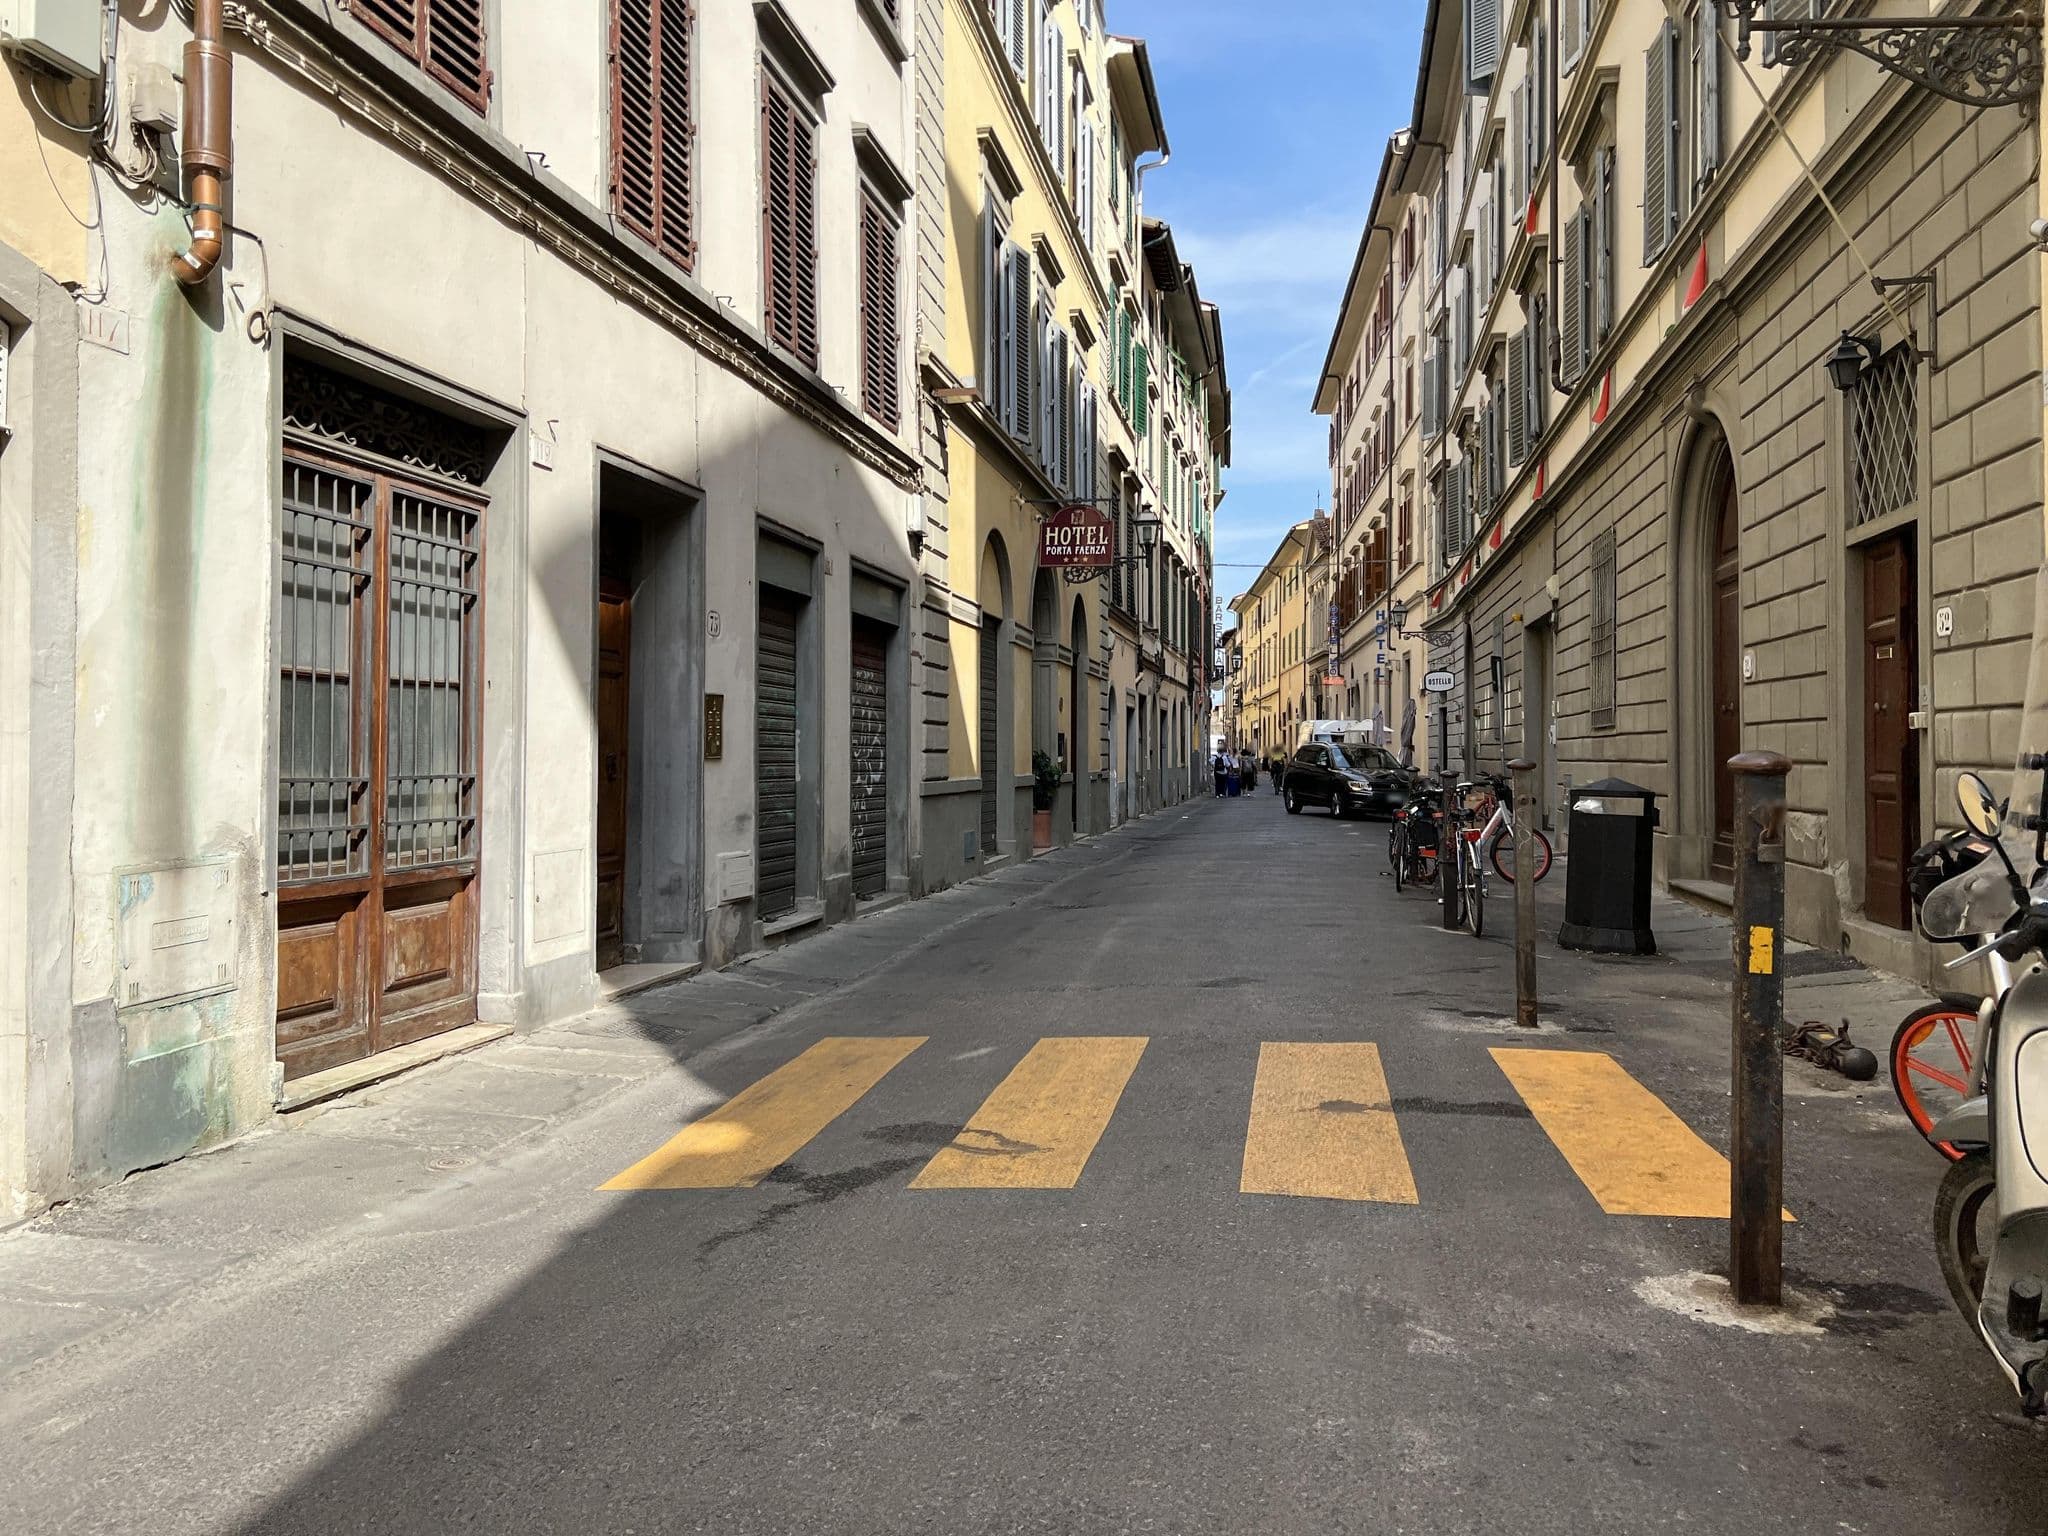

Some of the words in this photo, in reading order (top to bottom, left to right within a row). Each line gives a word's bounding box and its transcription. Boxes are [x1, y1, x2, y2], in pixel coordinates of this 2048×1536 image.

[1045, 526, 1109, 545] HOTEL
[1045, 546, 1072, 556] PORTA
[1075, 545, 1106, 555] FAENZA
[1375, 610, 1385, 678] HOTEL
[1428, 677, 1452, 686] OSTELLO
